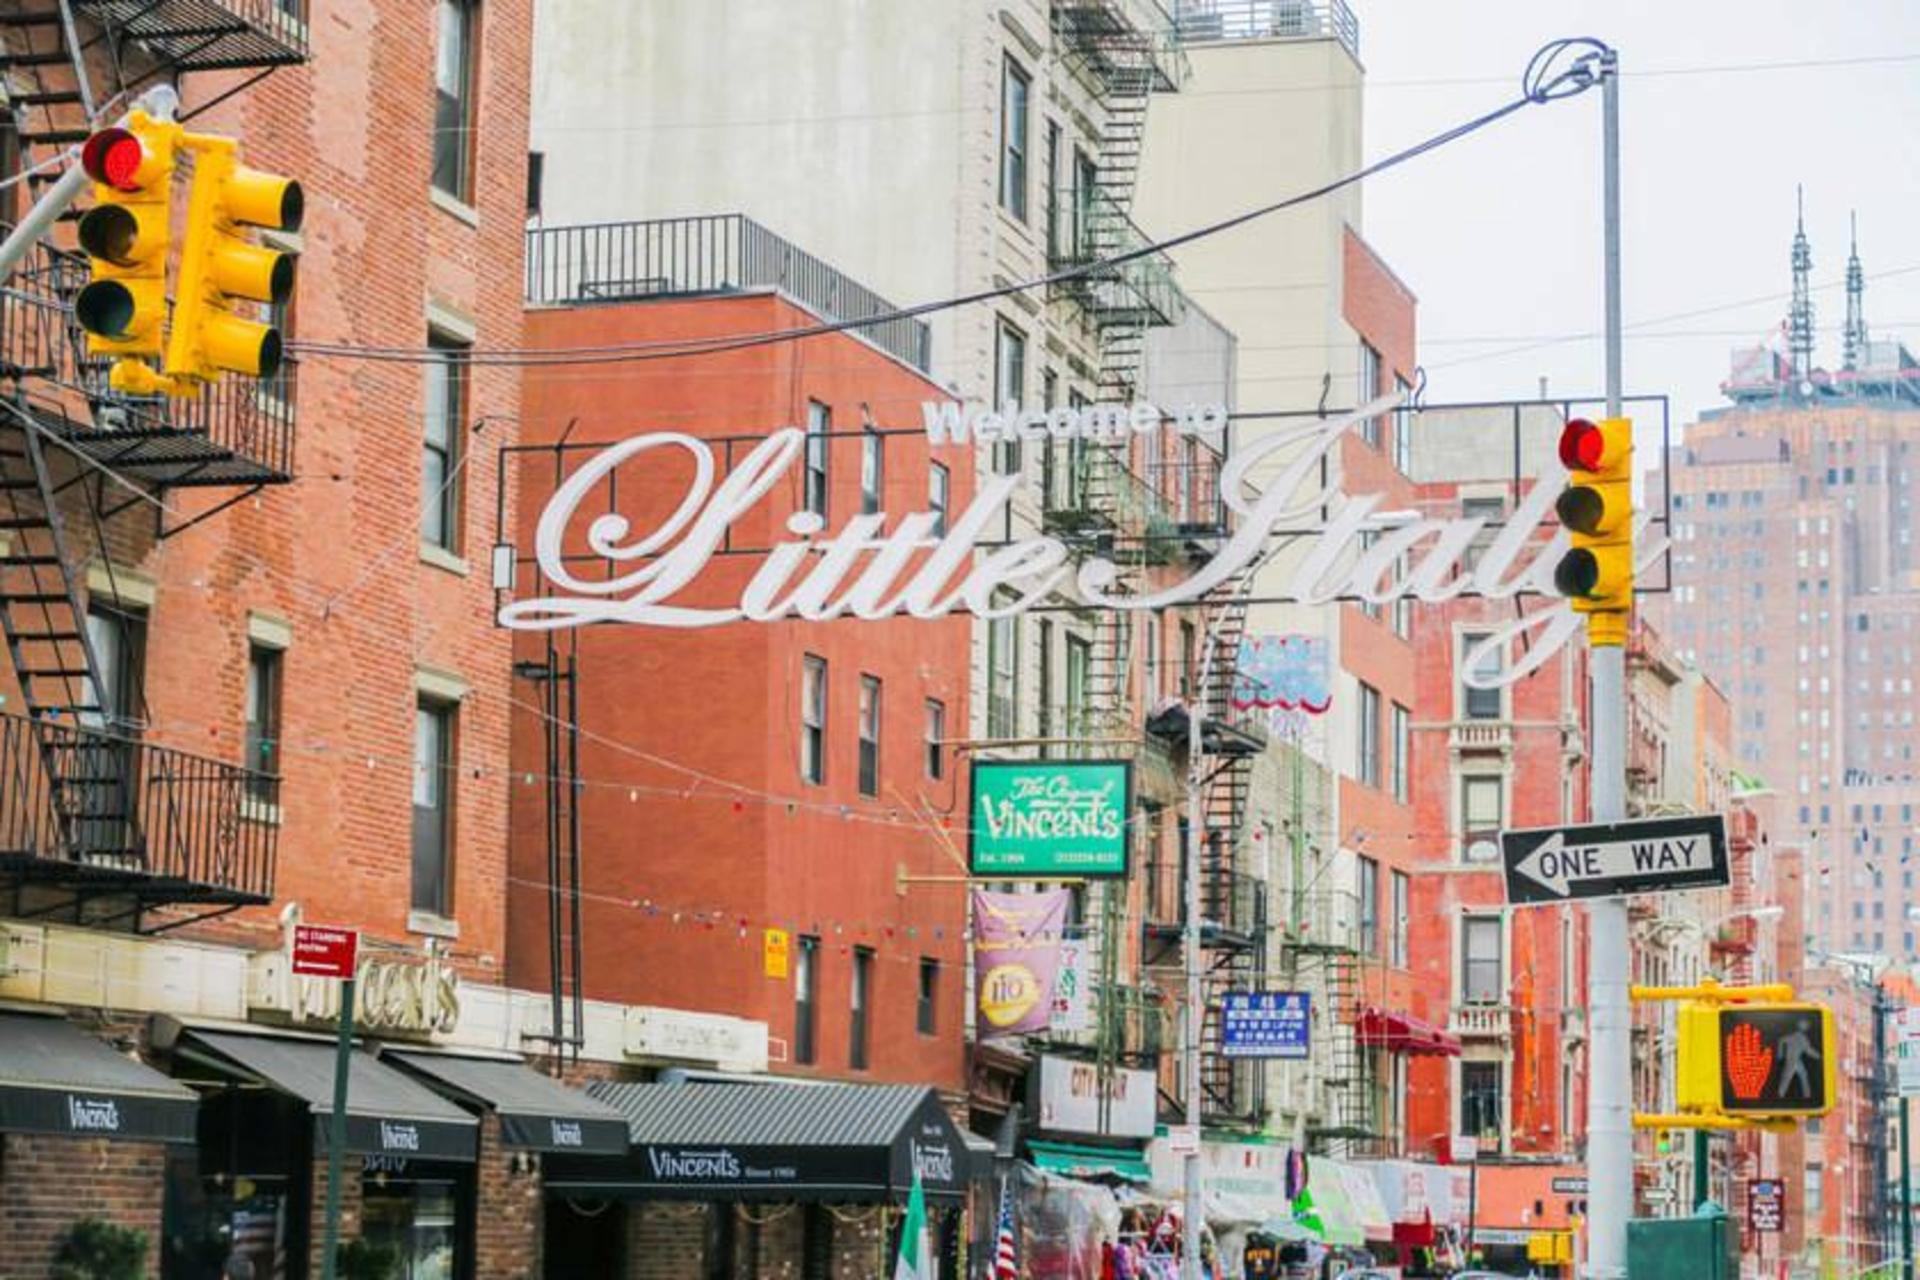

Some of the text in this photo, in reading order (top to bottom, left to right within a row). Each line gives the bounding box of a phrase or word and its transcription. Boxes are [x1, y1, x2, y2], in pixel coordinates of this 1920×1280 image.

[922, 400, 1228, 445] Welcome to
[499, 427, 1072, 631] Little
[1539, 839, 1696, 879] ONE WAY
